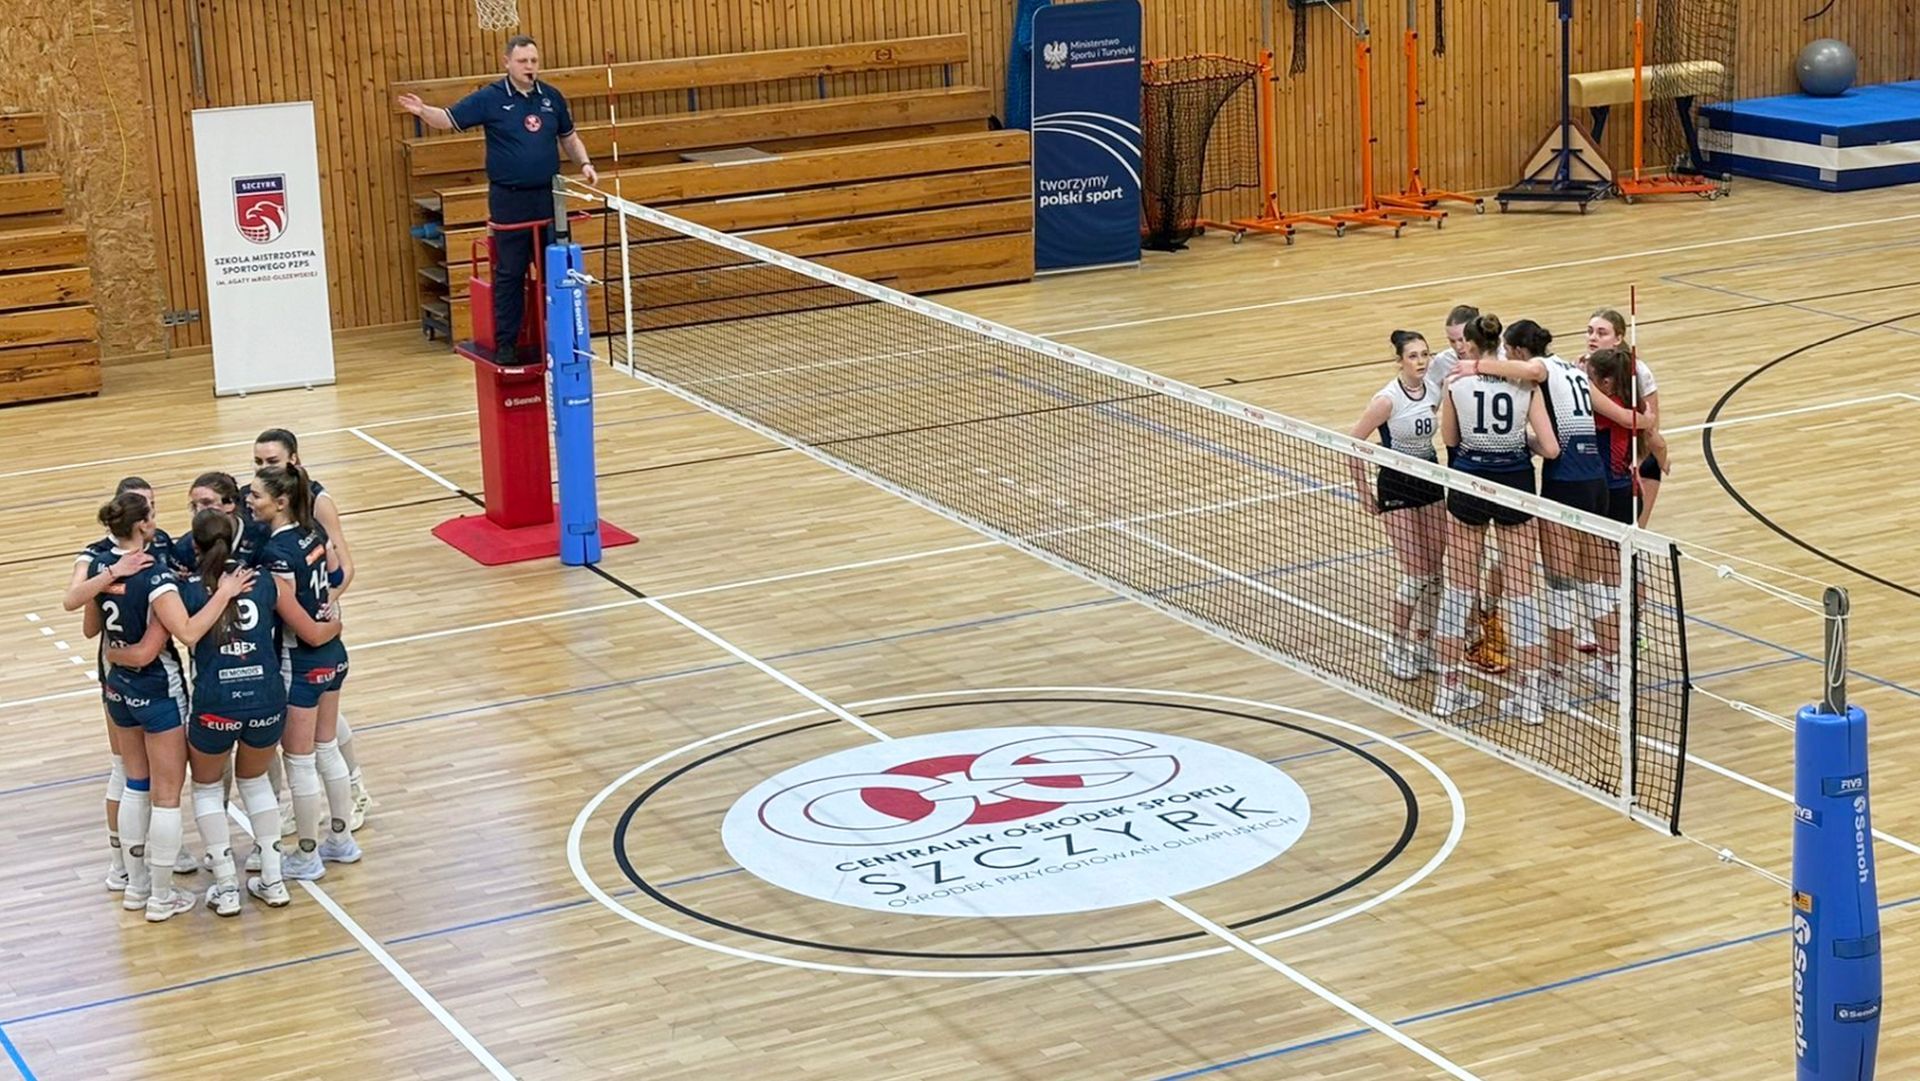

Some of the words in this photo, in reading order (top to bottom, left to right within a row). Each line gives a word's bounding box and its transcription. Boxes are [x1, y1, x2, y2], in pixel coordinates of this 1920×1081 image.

[1070, 38, 1120, 49] Ministerstwo
[1070, 50, 1096, 61] Sportu
[1101, 45, 1136, 57] Turystyki
[241, 181, 277, 190] SZCZYRK
[1040, 175, 1109, 191] tworzymy
[1040, 190, 1083, 208] polski
[1085, 186, 1123, 205] sport
[252, 250, 316, 262] MISTRZOSTWA
[222, 262, 286, 275] SPORTOWEGO
[288, 260, 310, 268] PZPS
[228, 277, 250, 285] AGATY
[1565, 375, 1593, 417] 16
[1473, 390, 1514, 436] 19
[1415, 418, 1432, 437] 88
[309, 561, 330, 600] 14
[102, 600, 124, 632] 2
[220, 641, 257, 656] ELBEX
[207, 721, 243, 735] EURO
[248, 714, 281, 728] DACH
[1840, 778, 1863, 790] FIVB
[835, 833, 995, 872] CENTRALNY
[1003, 805, 1135, 838] OŚRODEK
[1137, 784, 1236, 811] SPORTU
[858, 796, 1278, 895] SZCZYRK
[1854, 815, 1869, 883] Senoh
[887, 880, 994, 907] OŚRODEK
[994, 844, 1158, 886] PRZYGOTOWAŃ
[1162, 815, 1299, 849] OLIMPIJSKICH
[1794, 945, 1808, 1058] Senoh
[1849, 1006, 1878, 1018] Senoh
